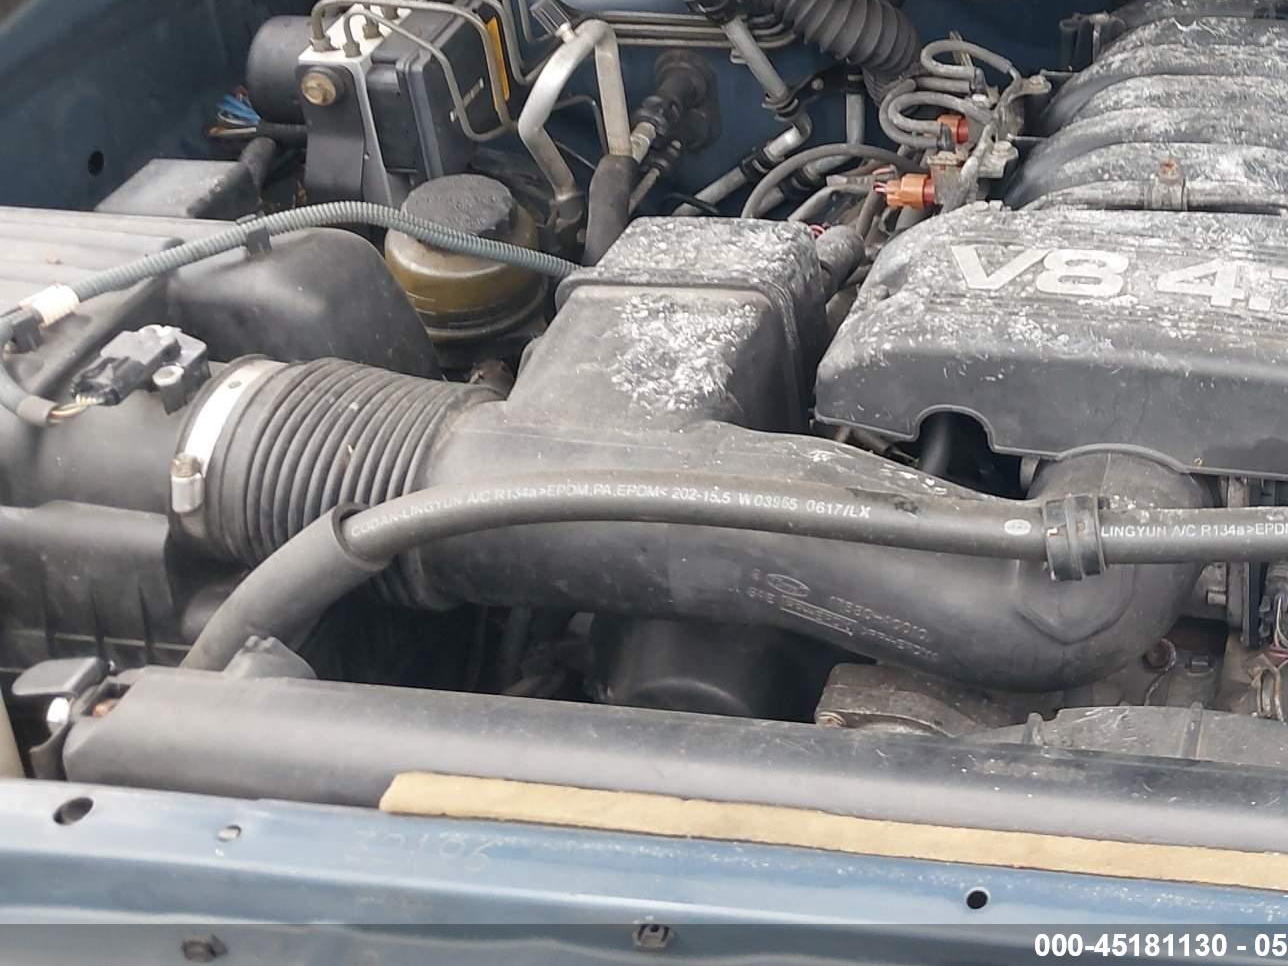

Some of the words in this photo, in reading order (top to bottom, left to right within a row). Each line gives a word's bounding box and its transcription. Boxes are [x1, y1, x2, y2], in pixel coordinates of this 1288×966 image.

[951, 243, 1129, 296] V8
[1101, 525, 1166, 538] LINGYUN
[1171, 524, 1196, 536] A/C
